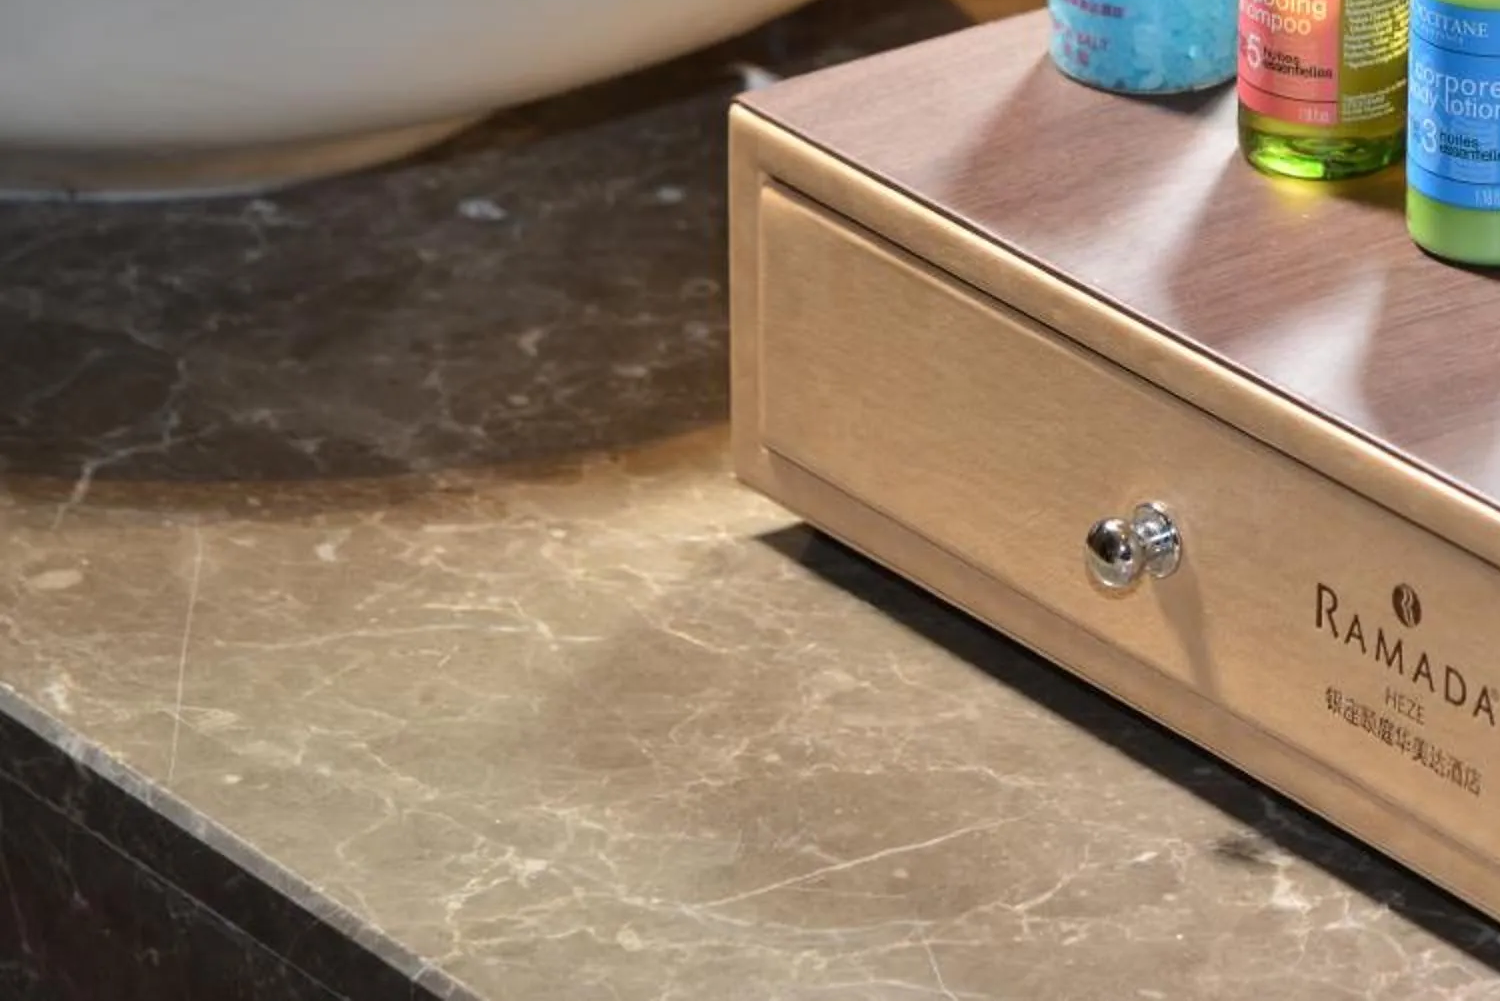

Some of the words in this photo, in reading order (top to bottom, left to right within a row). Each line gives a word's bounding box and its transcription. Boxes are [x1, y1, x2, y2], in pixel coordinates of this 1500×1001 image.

[1247, 34, 1261, 69] 5
[1423, 119, 1437, 154] 3
[1385, 687, 1425, 726] HEZE
